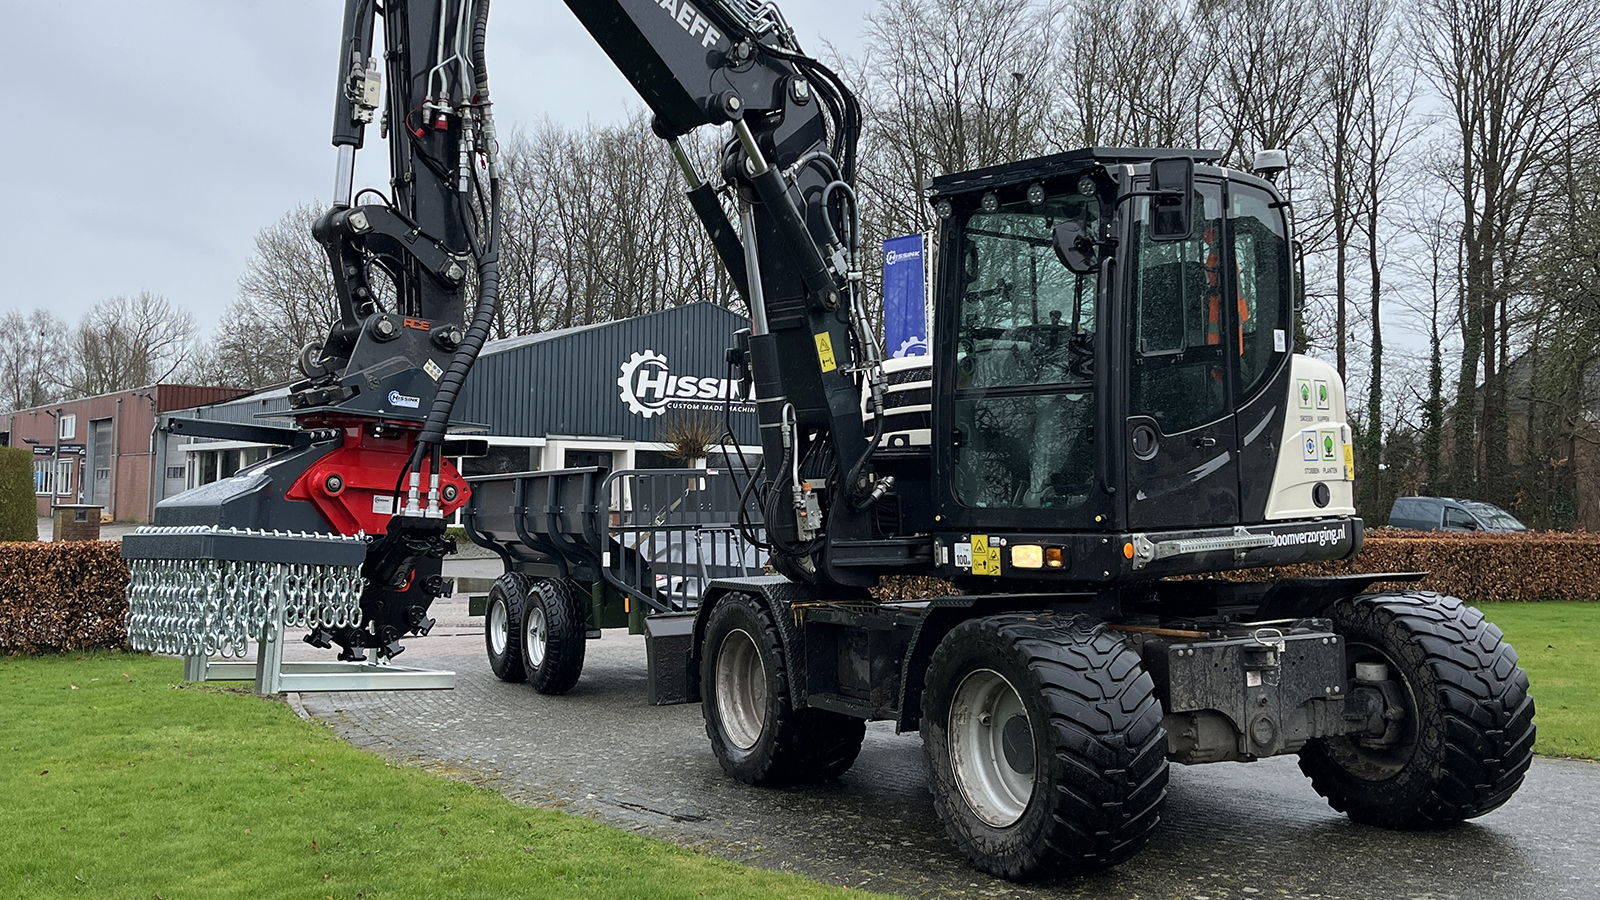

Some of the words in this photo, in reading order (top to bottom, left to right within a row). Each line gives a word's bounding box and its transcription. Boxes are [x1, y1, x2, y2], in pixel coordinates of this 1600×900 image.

[653, 0, 720, 48] AEFF
[636, 370, 757, 400] HISSIN
[667, 402, 699, 410] CUSTOM
[729, 405, 756, 413] ACHIN
